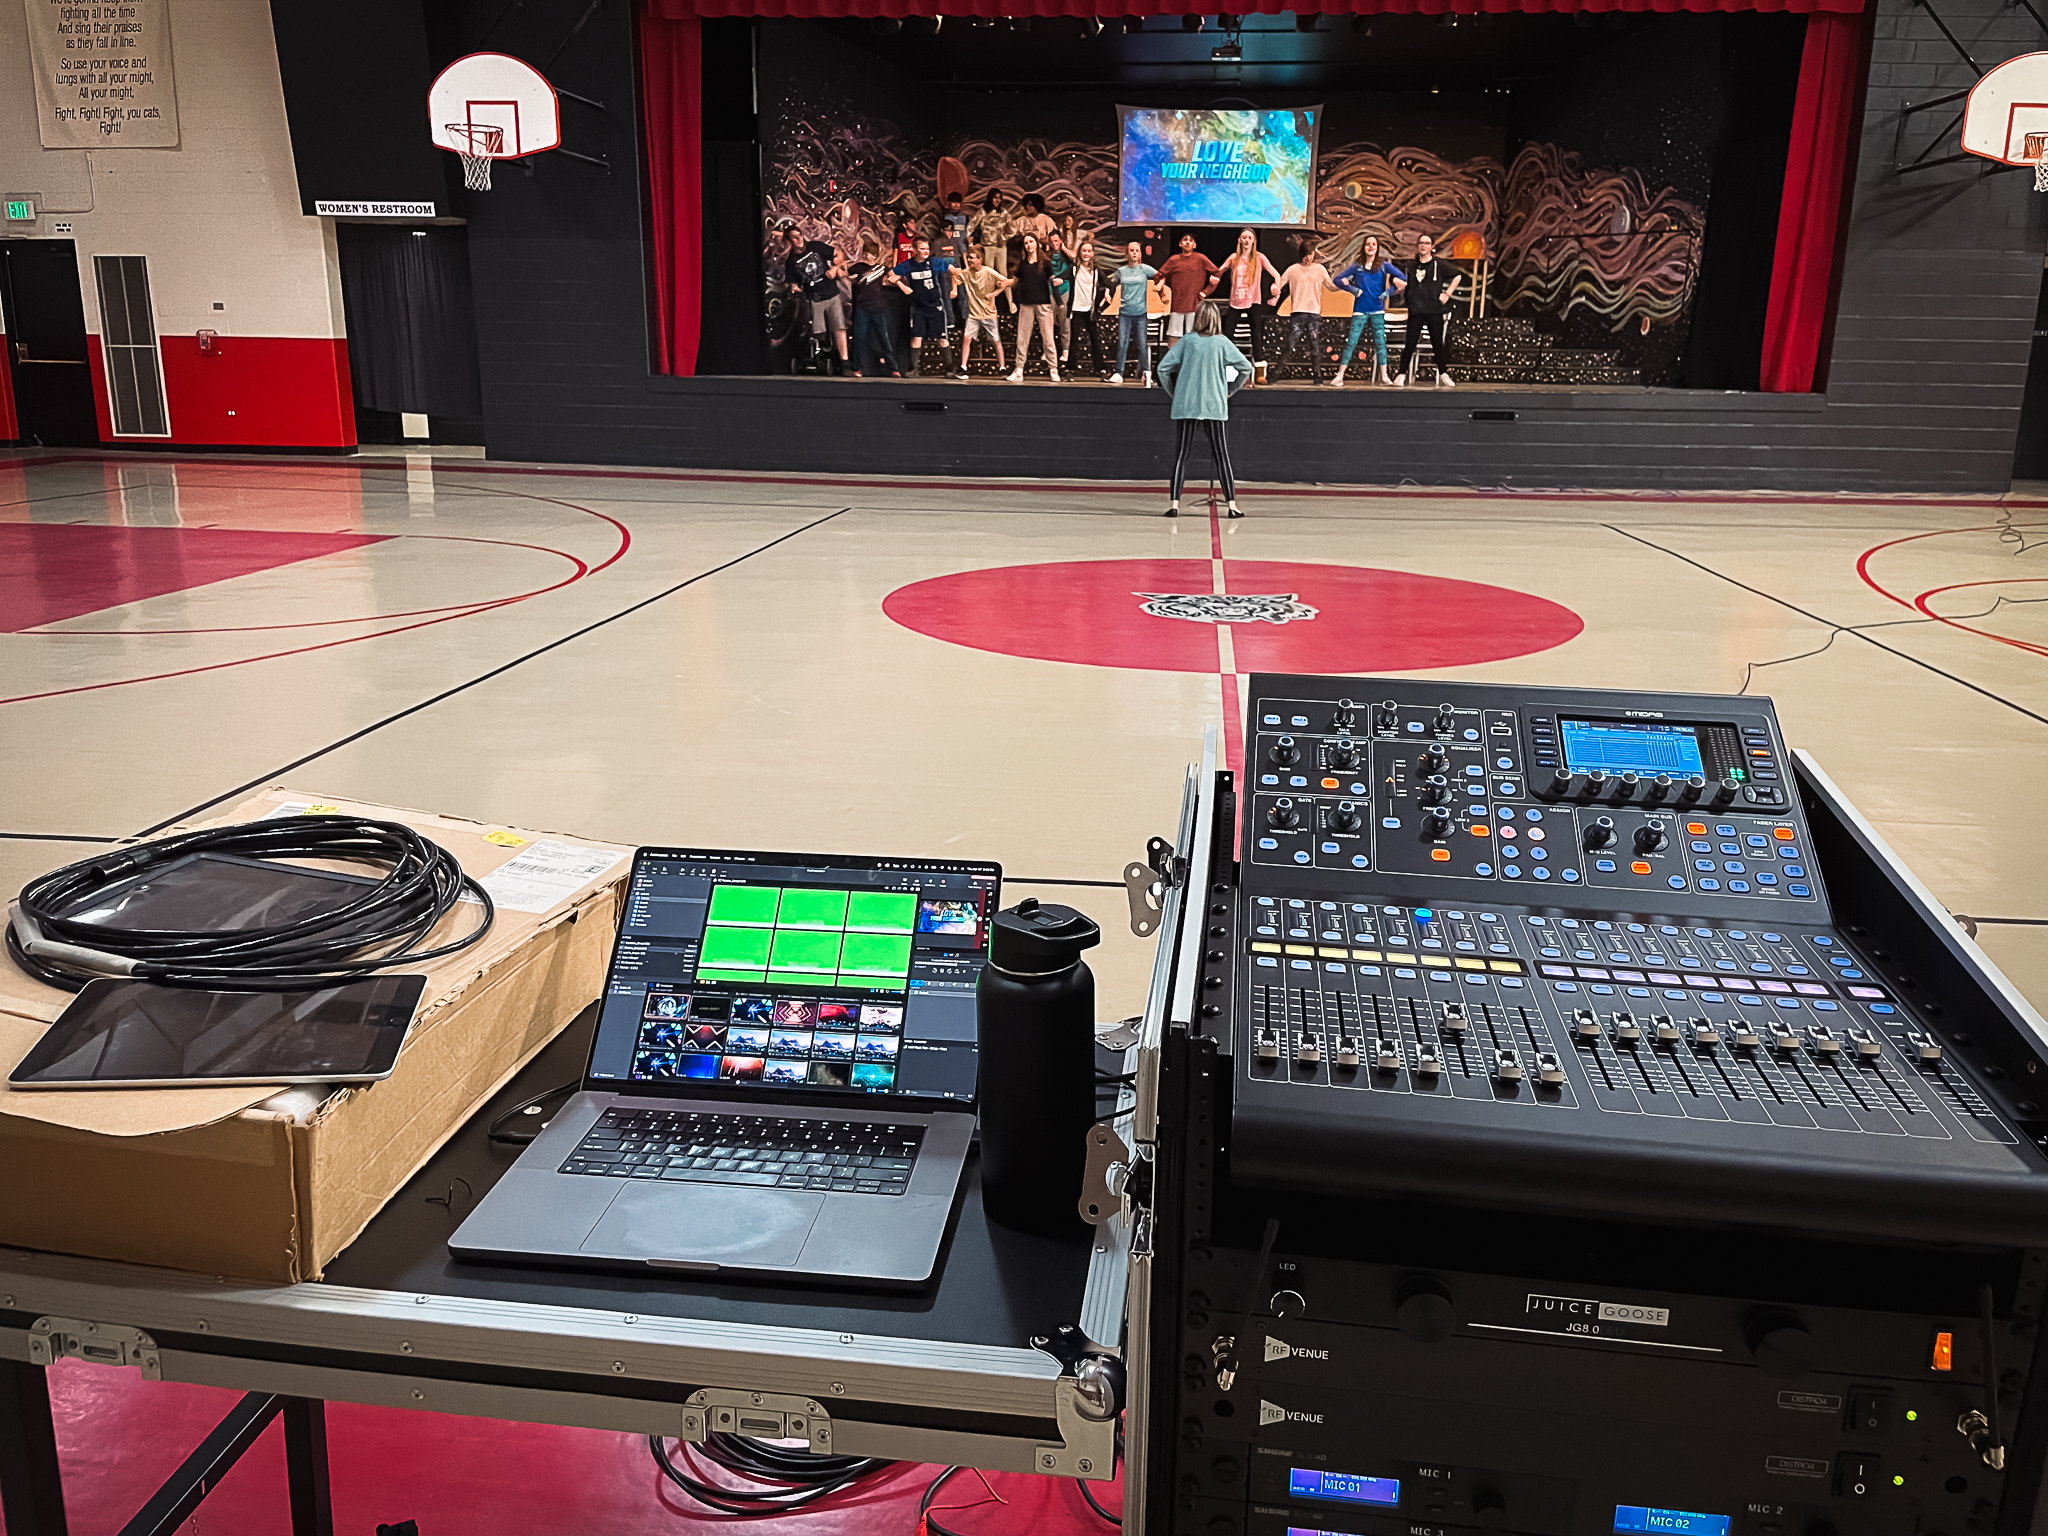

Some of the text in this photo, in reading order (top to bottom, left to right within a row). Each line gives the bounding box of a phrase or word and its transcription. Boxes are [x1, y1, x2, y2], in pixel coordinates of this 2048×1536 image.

[60, 7, 136, 21] fighting all the time
[58, 21, 142, 36] And sing their praises
[66, 36, 136, 50] as they fall in line.
[61, 56, 147, 71] So use your voice and
[55, 71, 154, 86] lungs with all your might,
[79, 86, 134, 101] All your might,
[55, 106, 161, 121] Fight, Fight! Fight, you cats,
[100, 122, 121, 135] Fight!
[1191, 140, 1245, 162] LOVE
[1161, 162, 1272, 181] YOUR NEIGHBOR
[8, 201, 28, 219] EXIT
[318, 203, 433, 214] WOMEN'S RESTROOM
[1279, 1263, 1296, 1271] LED
[1532, 1299, 1664, 1321] JUICE GOOSE
[1272, 1345, 1329, 1360] RF VENUE
[1267, 1408, 1324, 1424] RF VENUE
[1418, 1467, 1440, 1478] MIC
[1324, 1479, 1361, 1493] MIC 01
[1748, 1504, 1783, 1515] MIC 2
[1650, 1516, 1690, 1529] MIC 02
[1410, 1526, 1431, 1536] MIC
